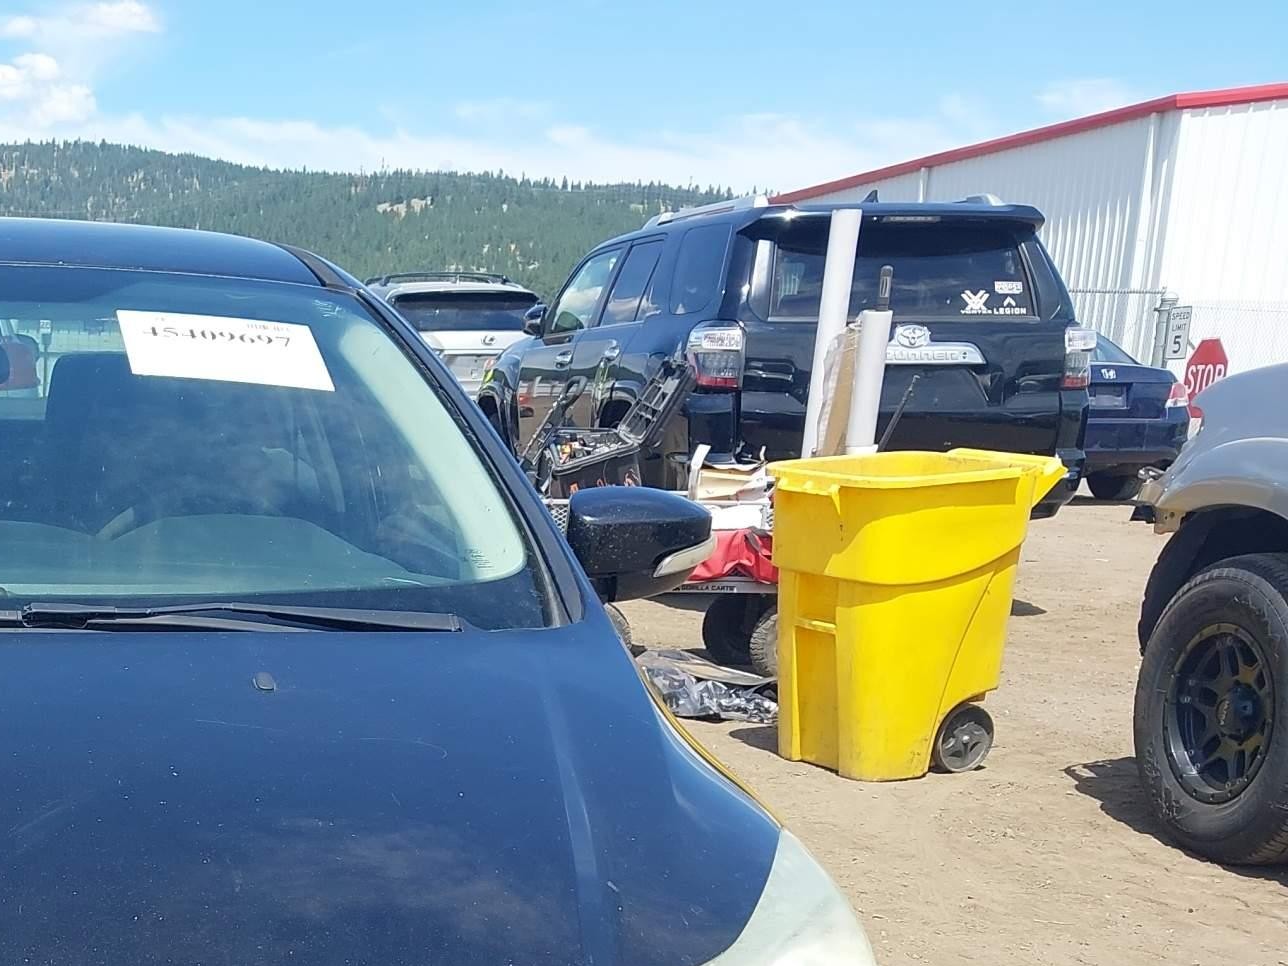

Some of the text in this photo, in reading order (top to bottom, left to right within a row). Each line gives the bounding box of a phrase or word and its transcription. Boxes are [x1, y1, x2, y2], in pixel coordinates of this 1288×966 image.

[993, 307, 1027, 315] LEGION
[1172, 311, 1190, 320] SPEED
[1172, 322, 1187, 331] LIMIT
[142, 326, 290, 347] 45409697
[1172, 335, 1182, 353] 5
[1186, 364, 1225, 394] STOP
